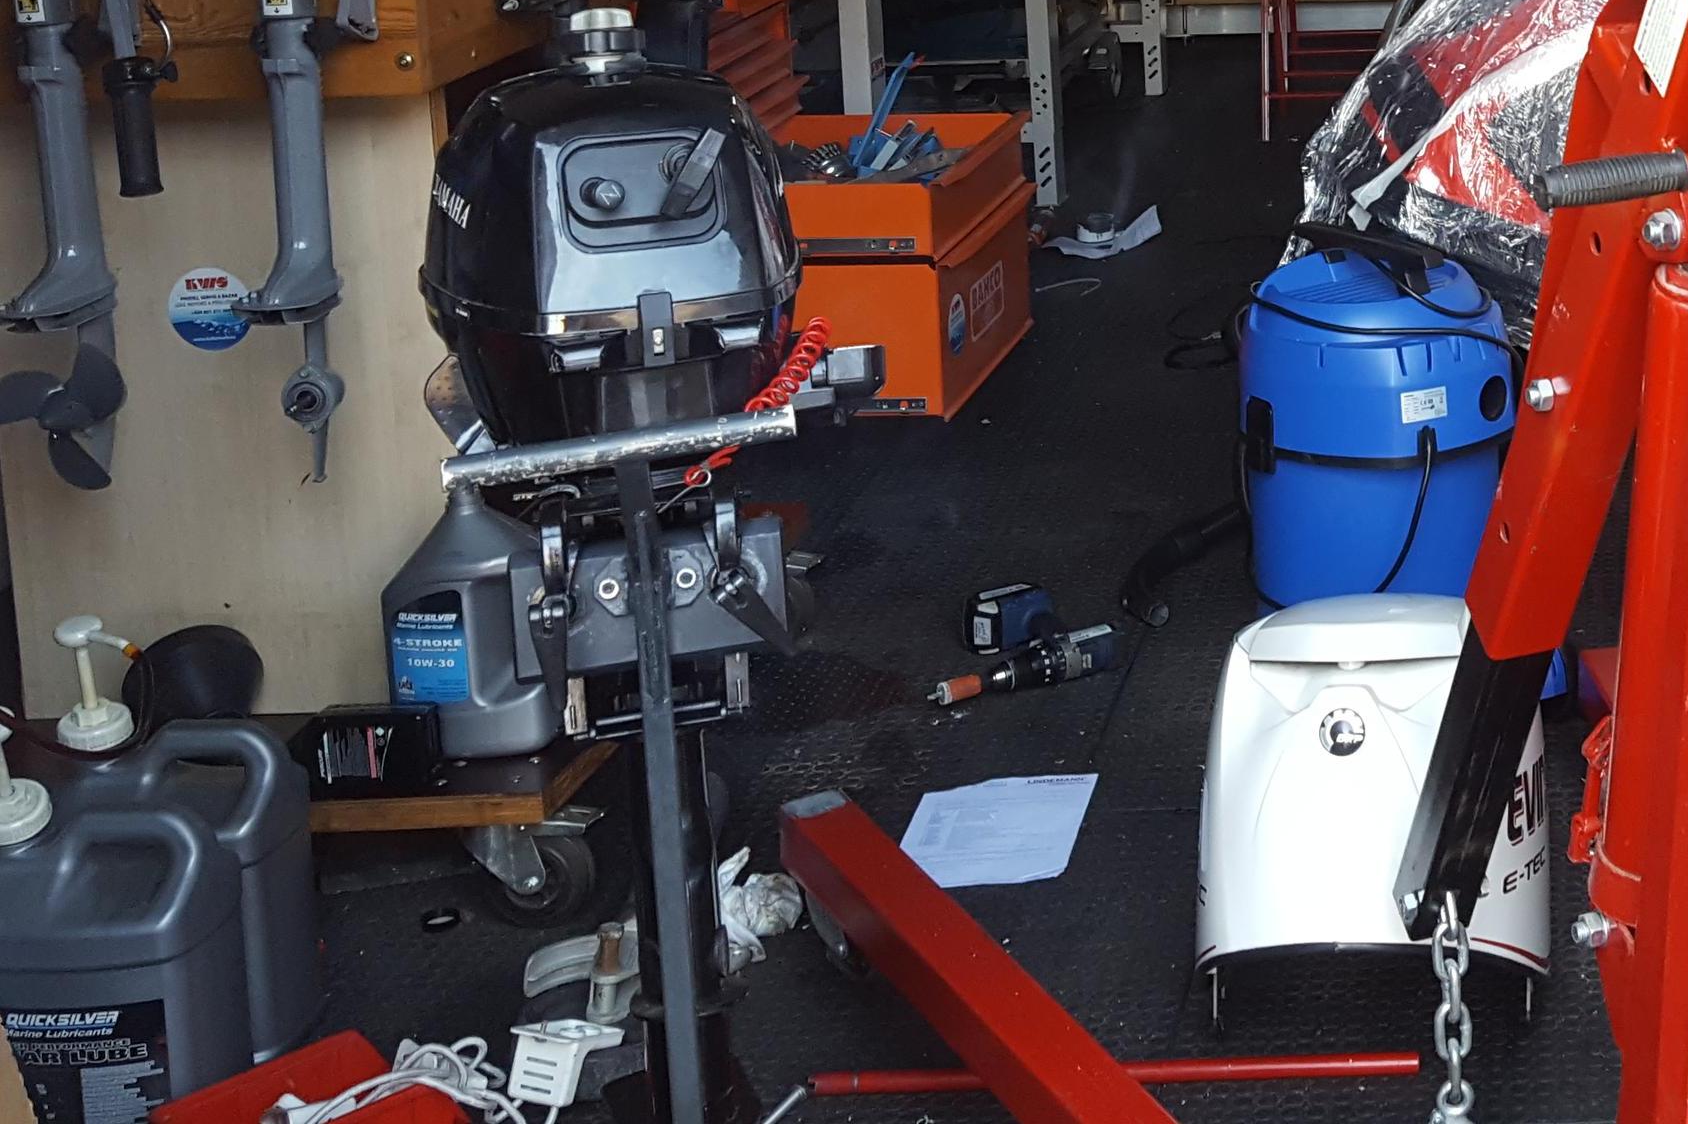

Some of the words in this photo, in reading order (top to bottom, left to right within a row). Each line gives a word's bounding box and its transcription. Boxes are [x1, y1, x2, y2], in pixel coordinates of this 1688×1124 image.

[398, 612, 457, 624] QUICKSILVER
[393, 637, 463, 648] 4-STROKE
[407, 657, 455, 668] 10W-30
[5, 1011, 120, 1028] QUICKSILVER
[46, 1027, 113, 1038] Lubricants
[32, 1037, 131, 1052] PERFORMANCE
[20, 1051, 62, 1066] AR
[69, 1043, 148, 1066] LUBE
